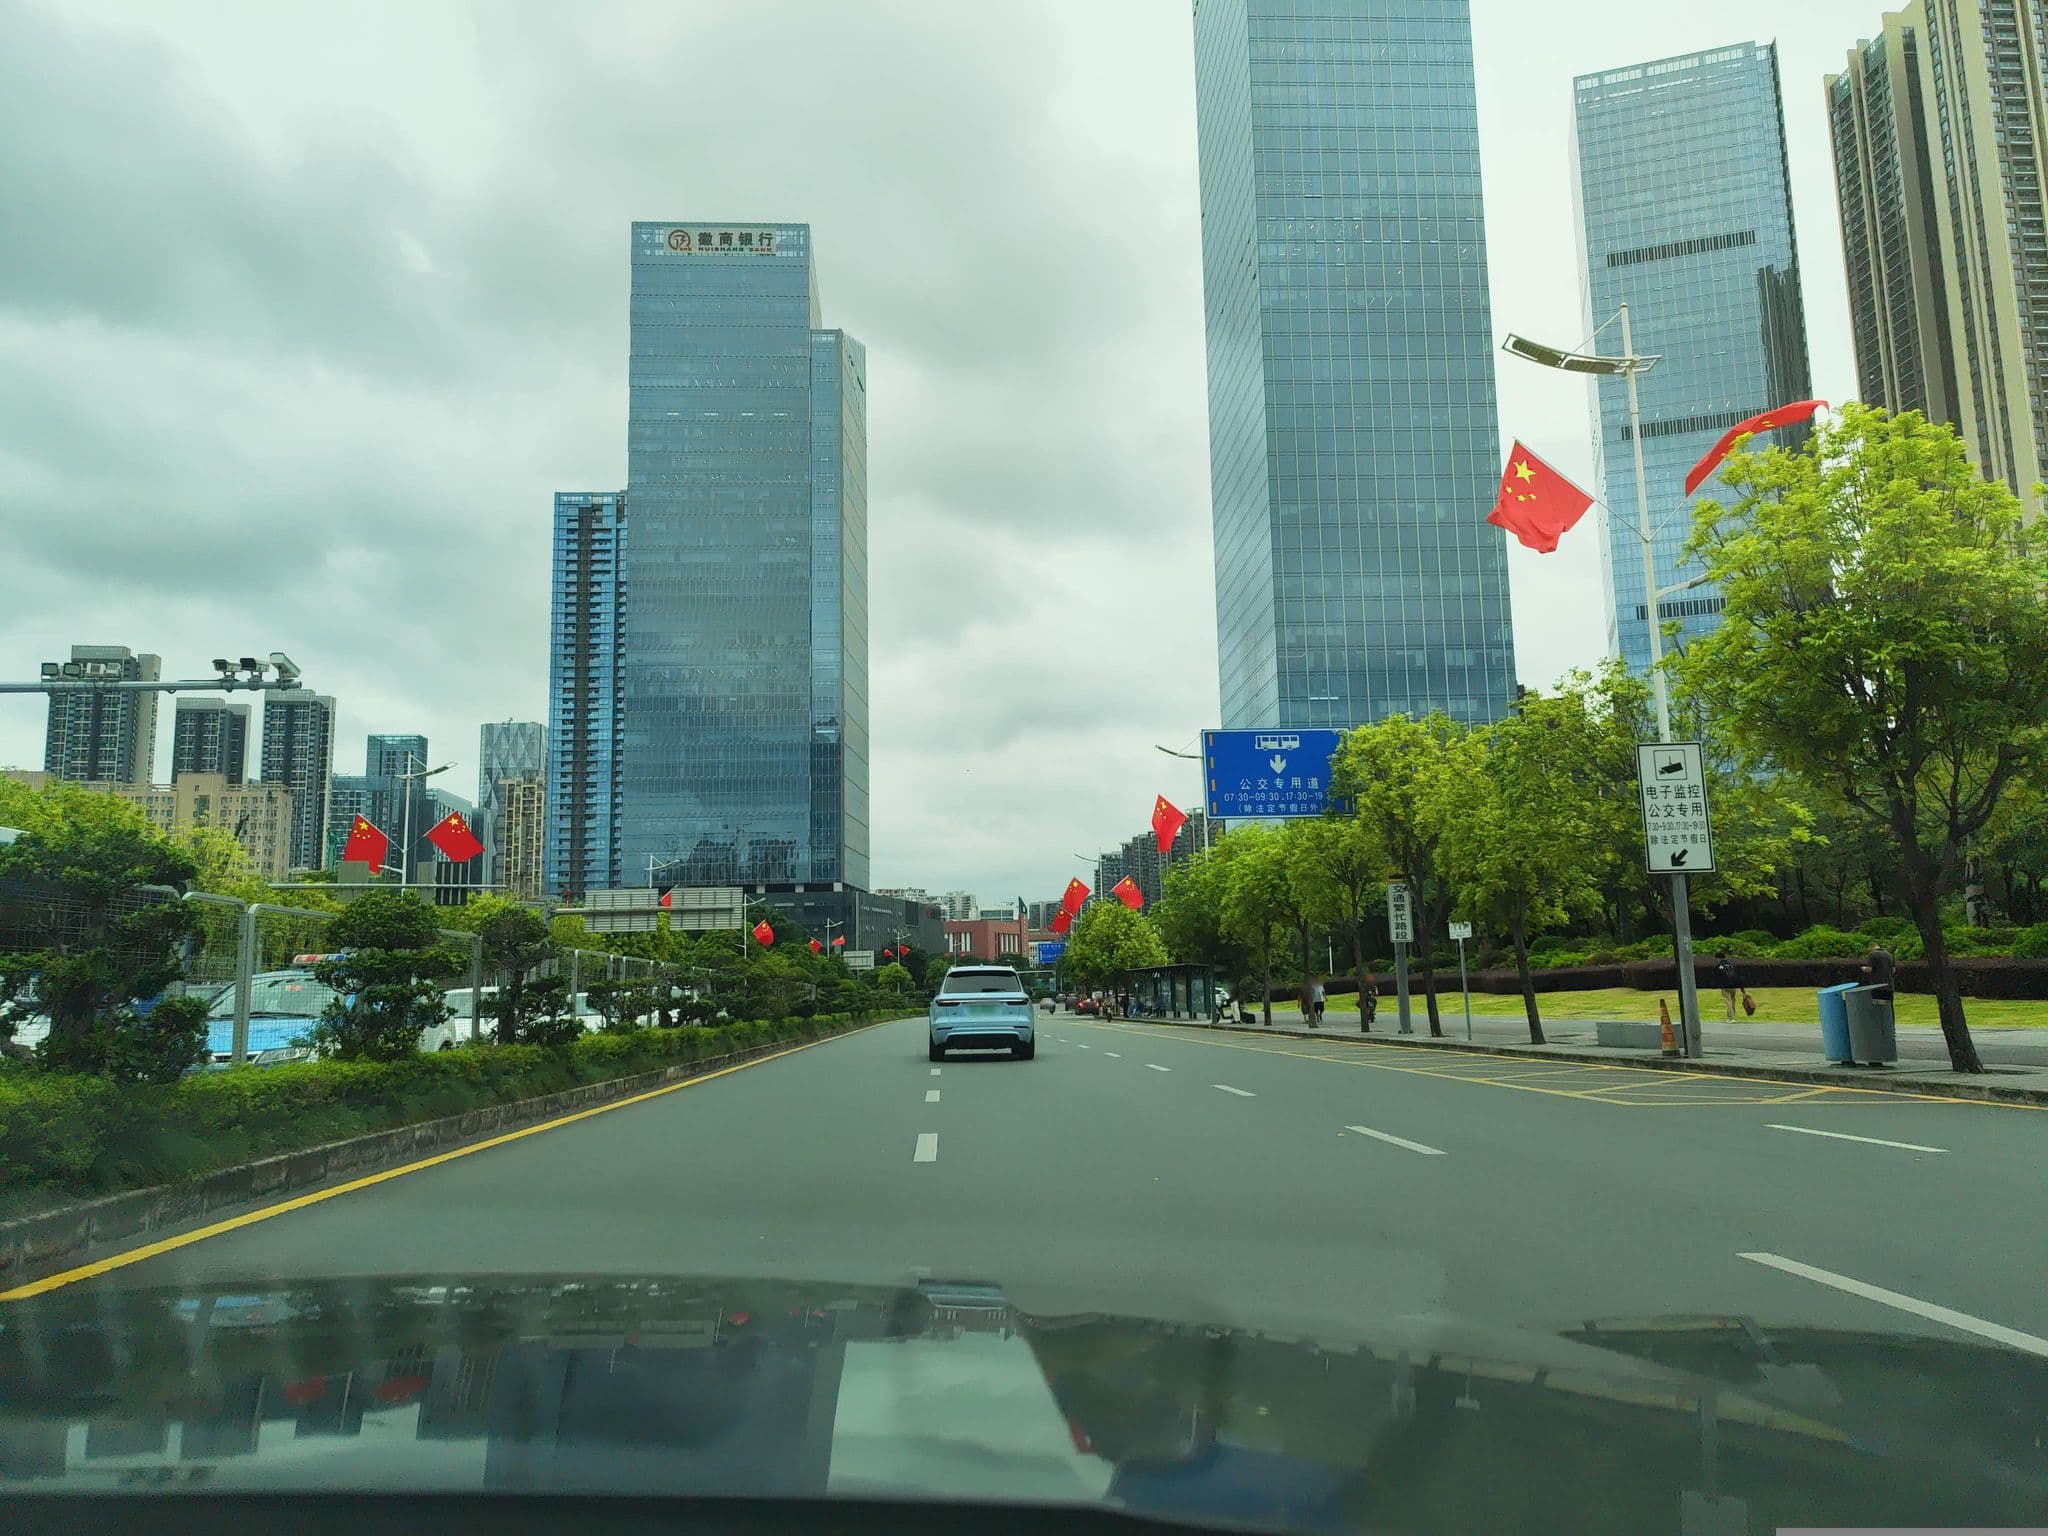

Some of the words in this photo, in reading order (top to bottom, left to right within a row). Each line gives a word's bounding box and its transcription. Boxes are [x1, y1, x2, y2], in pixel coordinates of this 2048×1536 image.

[698, 232, 774, 246] 徽商银行
[1240, 777, 1319, 790] 公交专用道
[1645, 784, 1701, 800] 电子监控
[1647, 802, 1703, 818] 公交专用
[1650, 833, 1707, 845] 除法定节假日
[1393, 885, 1409, 940] 交通繁忙路段
